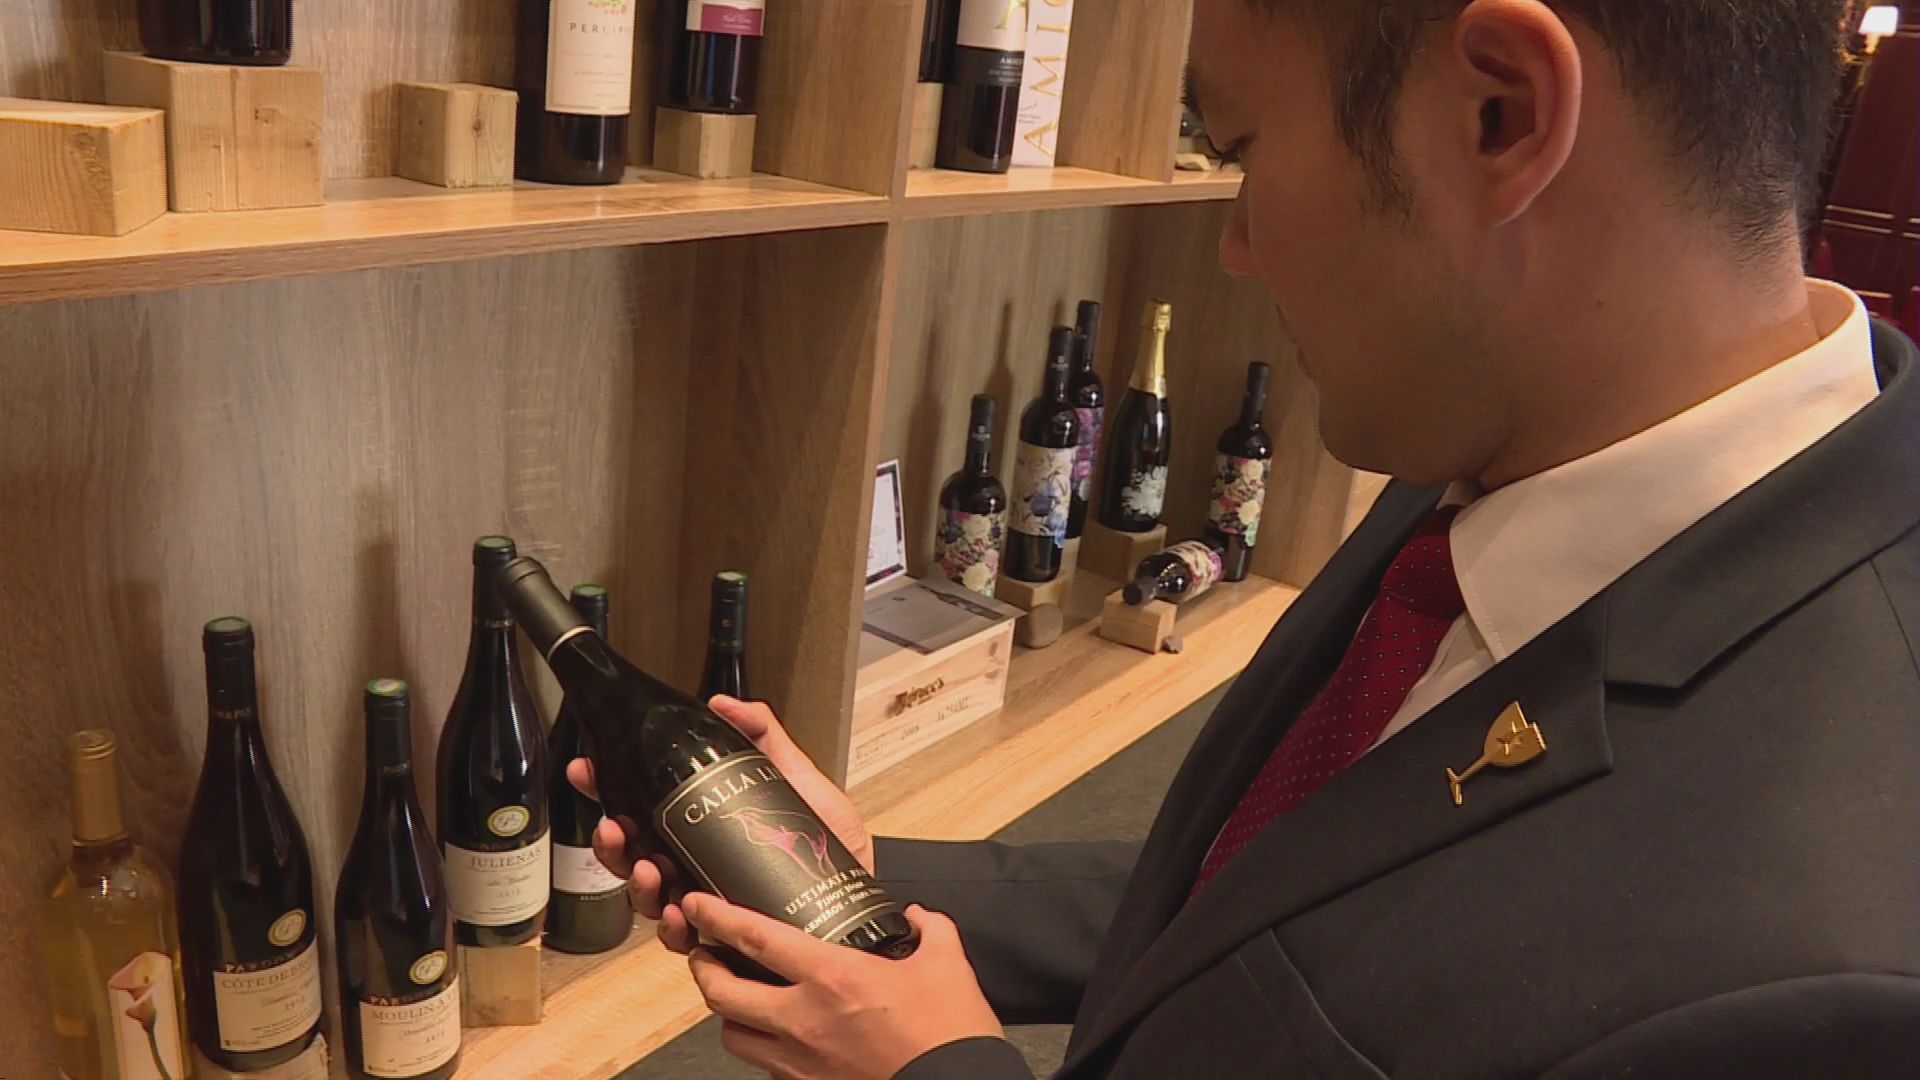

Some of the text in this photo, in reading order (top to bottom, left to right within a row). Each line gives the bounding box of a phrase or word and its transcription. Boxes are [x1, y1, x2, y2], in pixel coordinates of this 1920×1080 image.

[569, 22, 628, 34] PERCIP
[1024, 0, 1069, 159] AMI
[684, 765, 779, 824] CALLA LI
